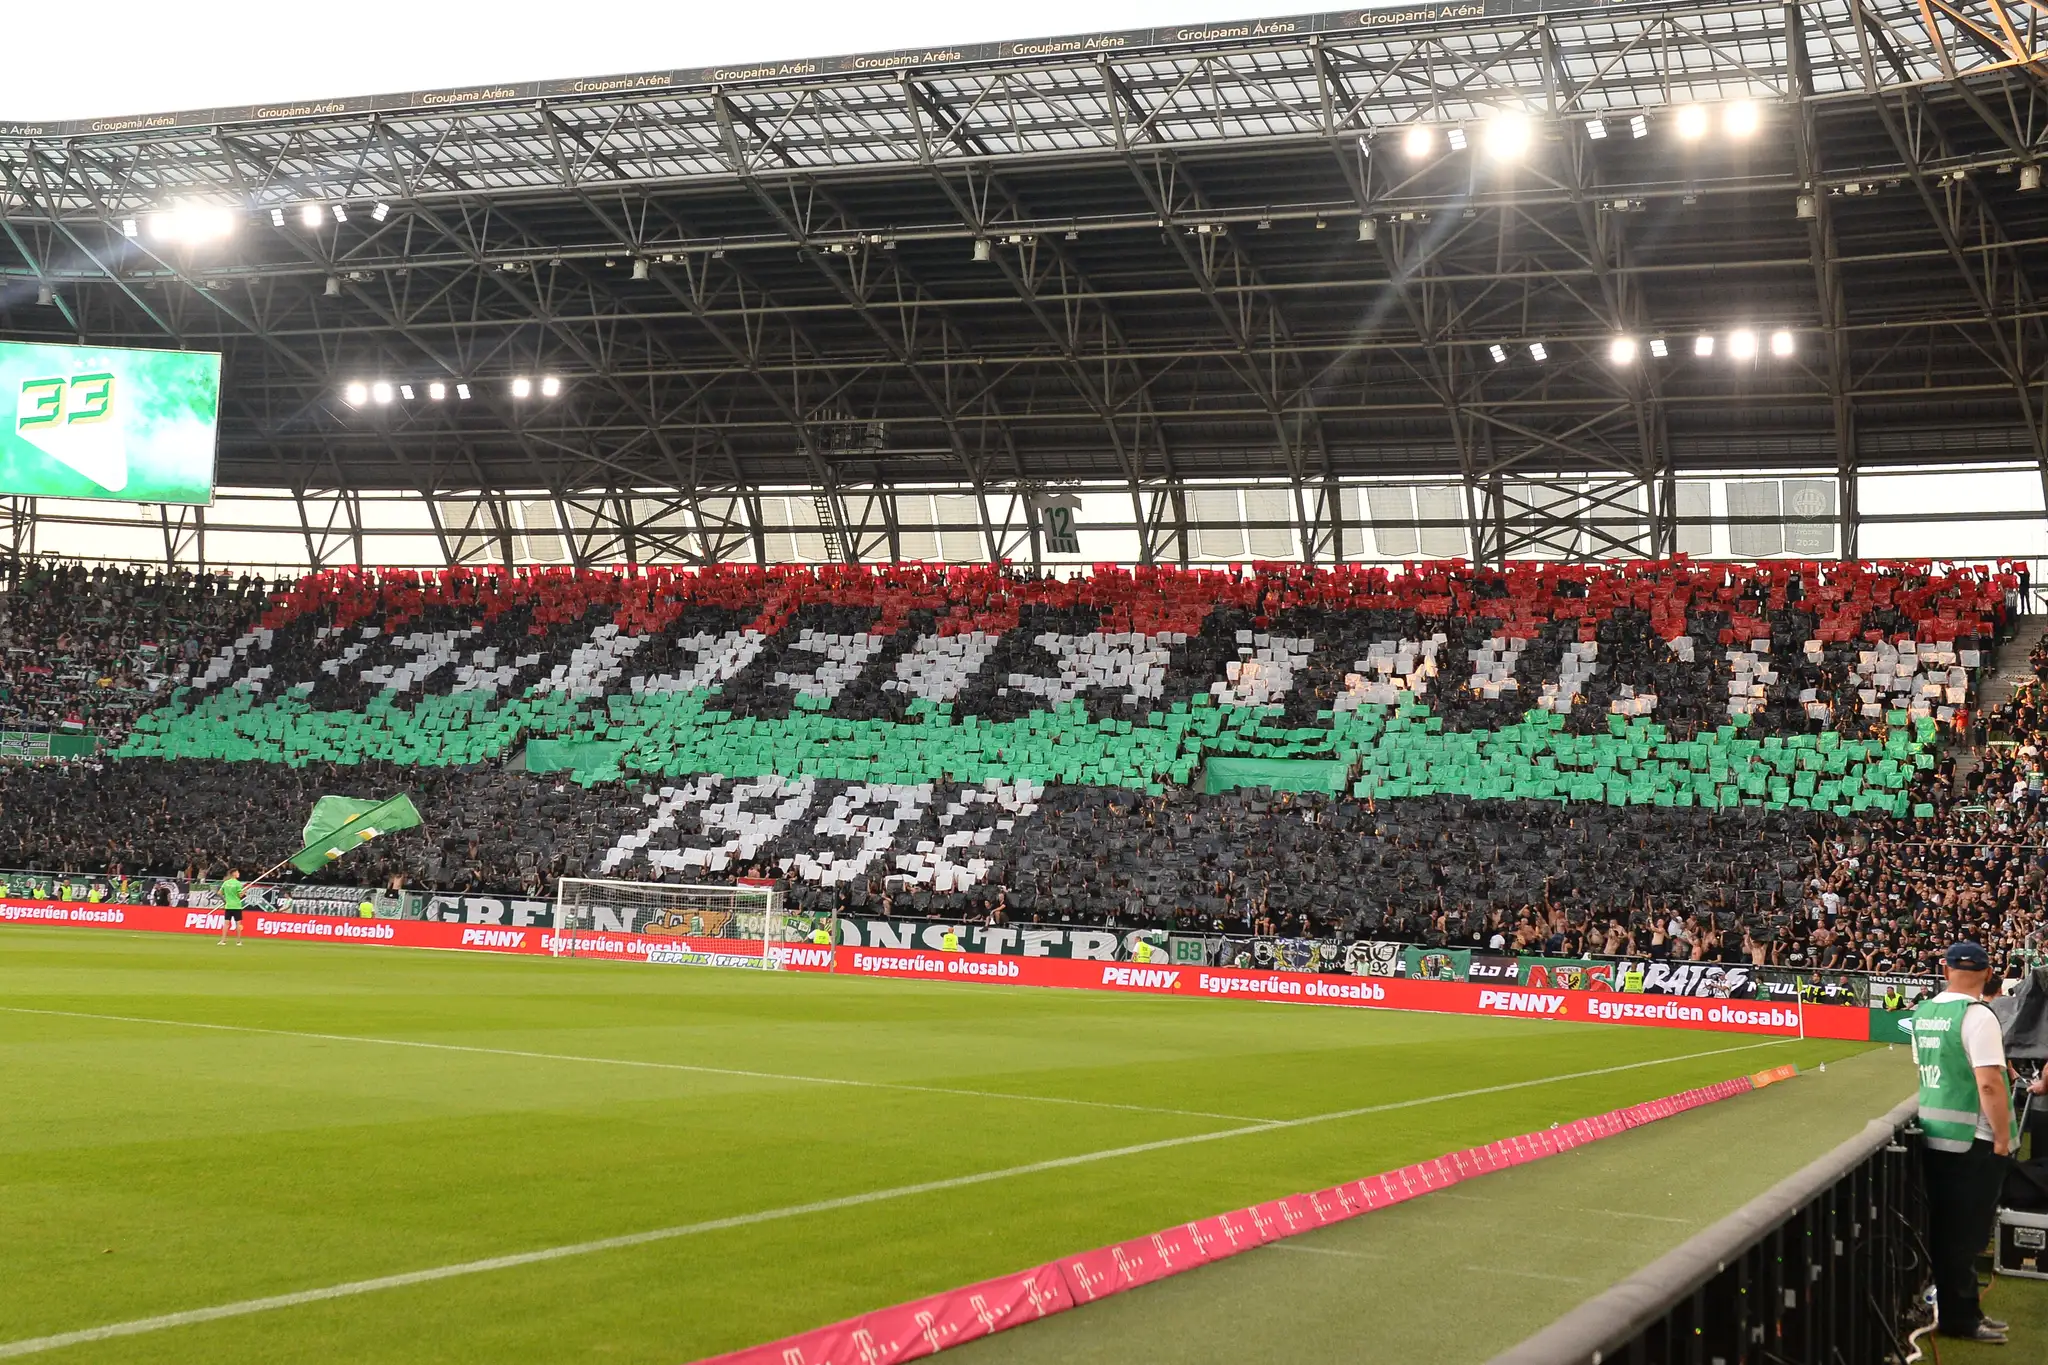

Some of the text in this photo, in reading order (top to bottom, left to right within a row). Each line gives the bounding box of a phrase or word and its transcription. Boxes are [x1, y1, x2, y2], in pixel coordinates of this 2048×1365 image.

[1360, 4, 1484, 27] Groupama Aréna
[1177, 21, 1296, 42] Groupama Aréna
[1013, 35, 1125, 56] Groupama Aréna
[855, 49, 961, 69] Groupama Aréna
[714, 61, 815, 81] Groupama Aréna
[574, 73, 671, 93] Groupama Aréna
[423, 87, 515, 105] Groupama Aréna
[257, 101, 345, 119] Groupama Aréna
[92, 114, 175, 131] Groupama Aréna
[19, 373, 115, 430] 33
[1045, 507, 1073, 538] 12
[70, 907, 124, 923] okosabb
[256, 917, 394, 939] Egyszerűen okosabb
[462, 929, 525, 948] PENNY
[541, 935, 626, 955] Egyszerűen
[840, 918, 1170, 965] ONSTERS
[1177, 941, 1201, 961] B3
[854, 953, 1019, 978] Egyszerűen okosabb
[1372, 961, 1389, 975] 93
[1102, 967, 1180, 989] PENNY
[1200, 973, 1300, 995] Egyszerűen
[1304, 979, 1385, 1001] okosabb
[1868, 975, 1935, 986] HOOLIGANS
[1479, 991, 1566, 1014] PENNY
[1588, 998, 1800, 1028] Egyszerűen okosabb
